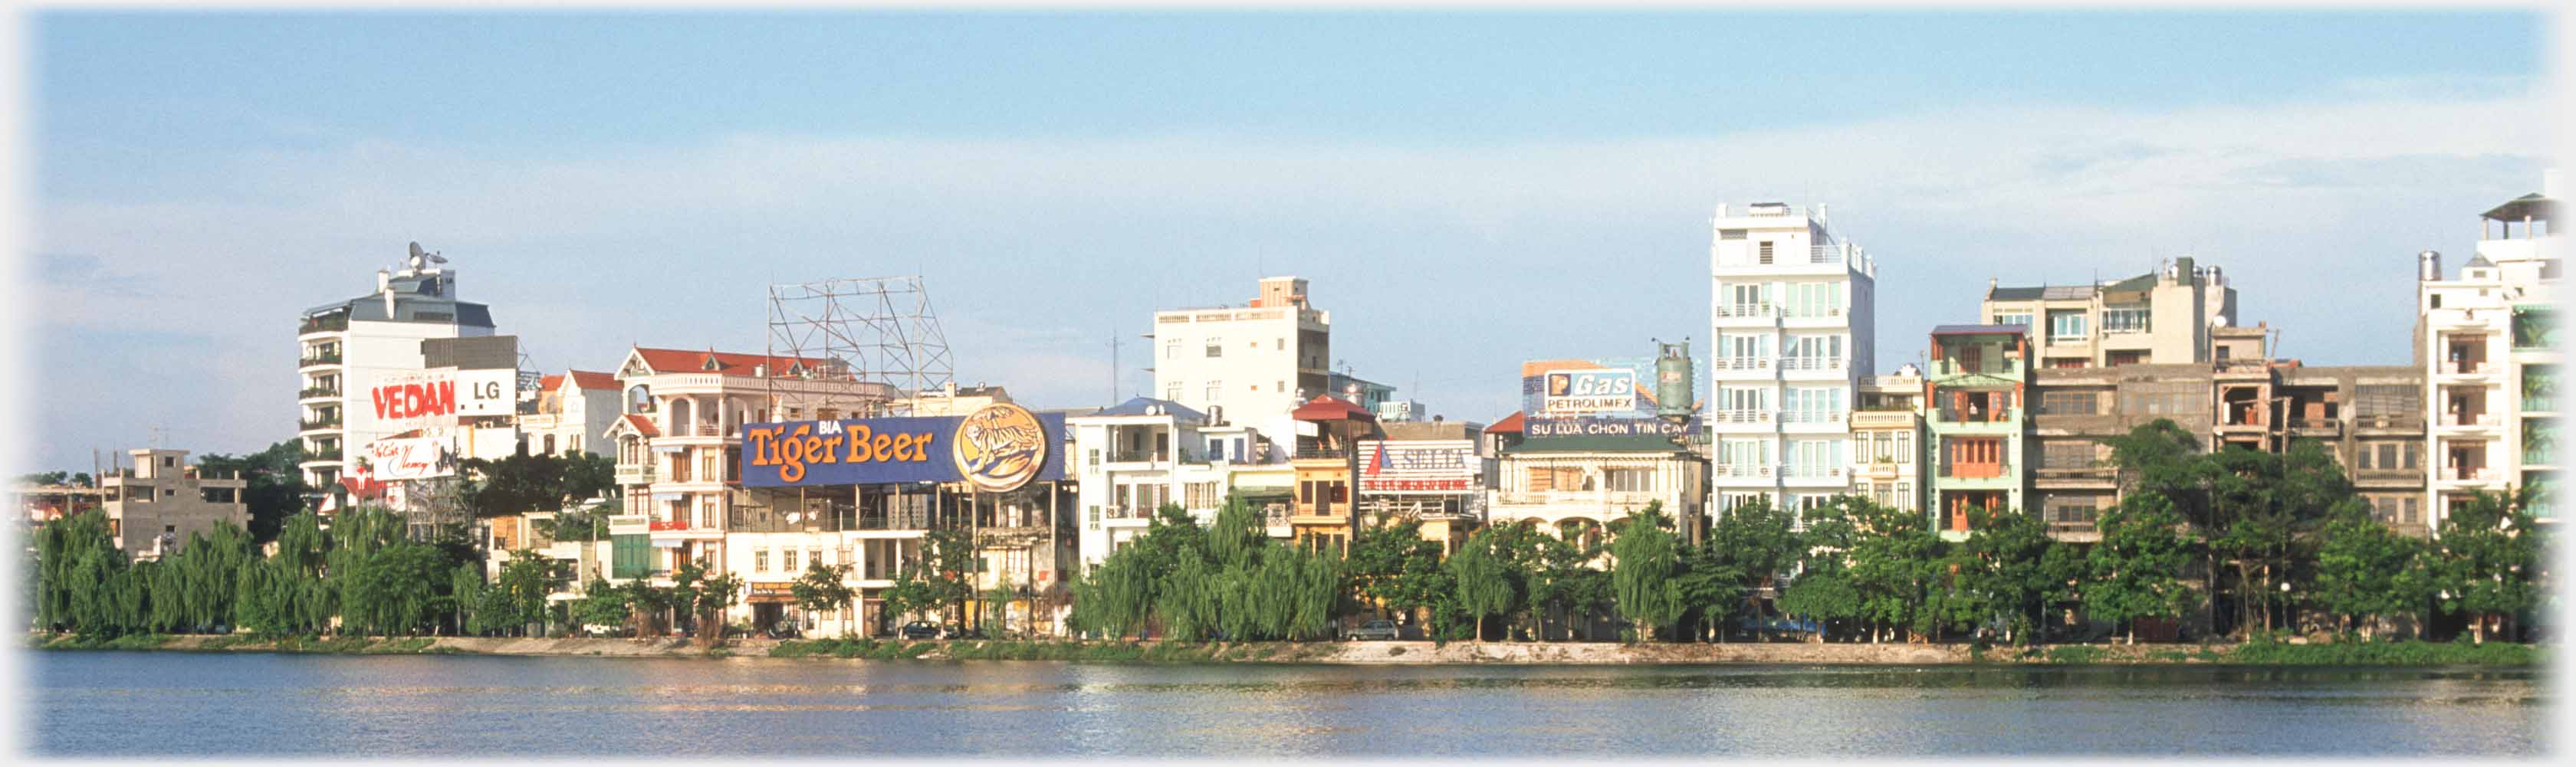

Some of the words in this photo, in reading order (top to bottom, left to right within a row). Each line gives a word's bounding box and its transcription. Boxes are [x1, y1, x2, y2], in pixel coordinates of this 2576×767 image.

[474, 382, 500, 399] LG
[1574, 375, 1630, 395] Gas
[372, 380, 455, 419] VEDAN
[1547, 398, 1631, 409] PETROLIMEX
[819, 421, 842, 434] BIA
[1634, 423, 1656, 434] TIN
[748, 424, 842, 482] Tiger
[846, 424, 933, 463] Beer
